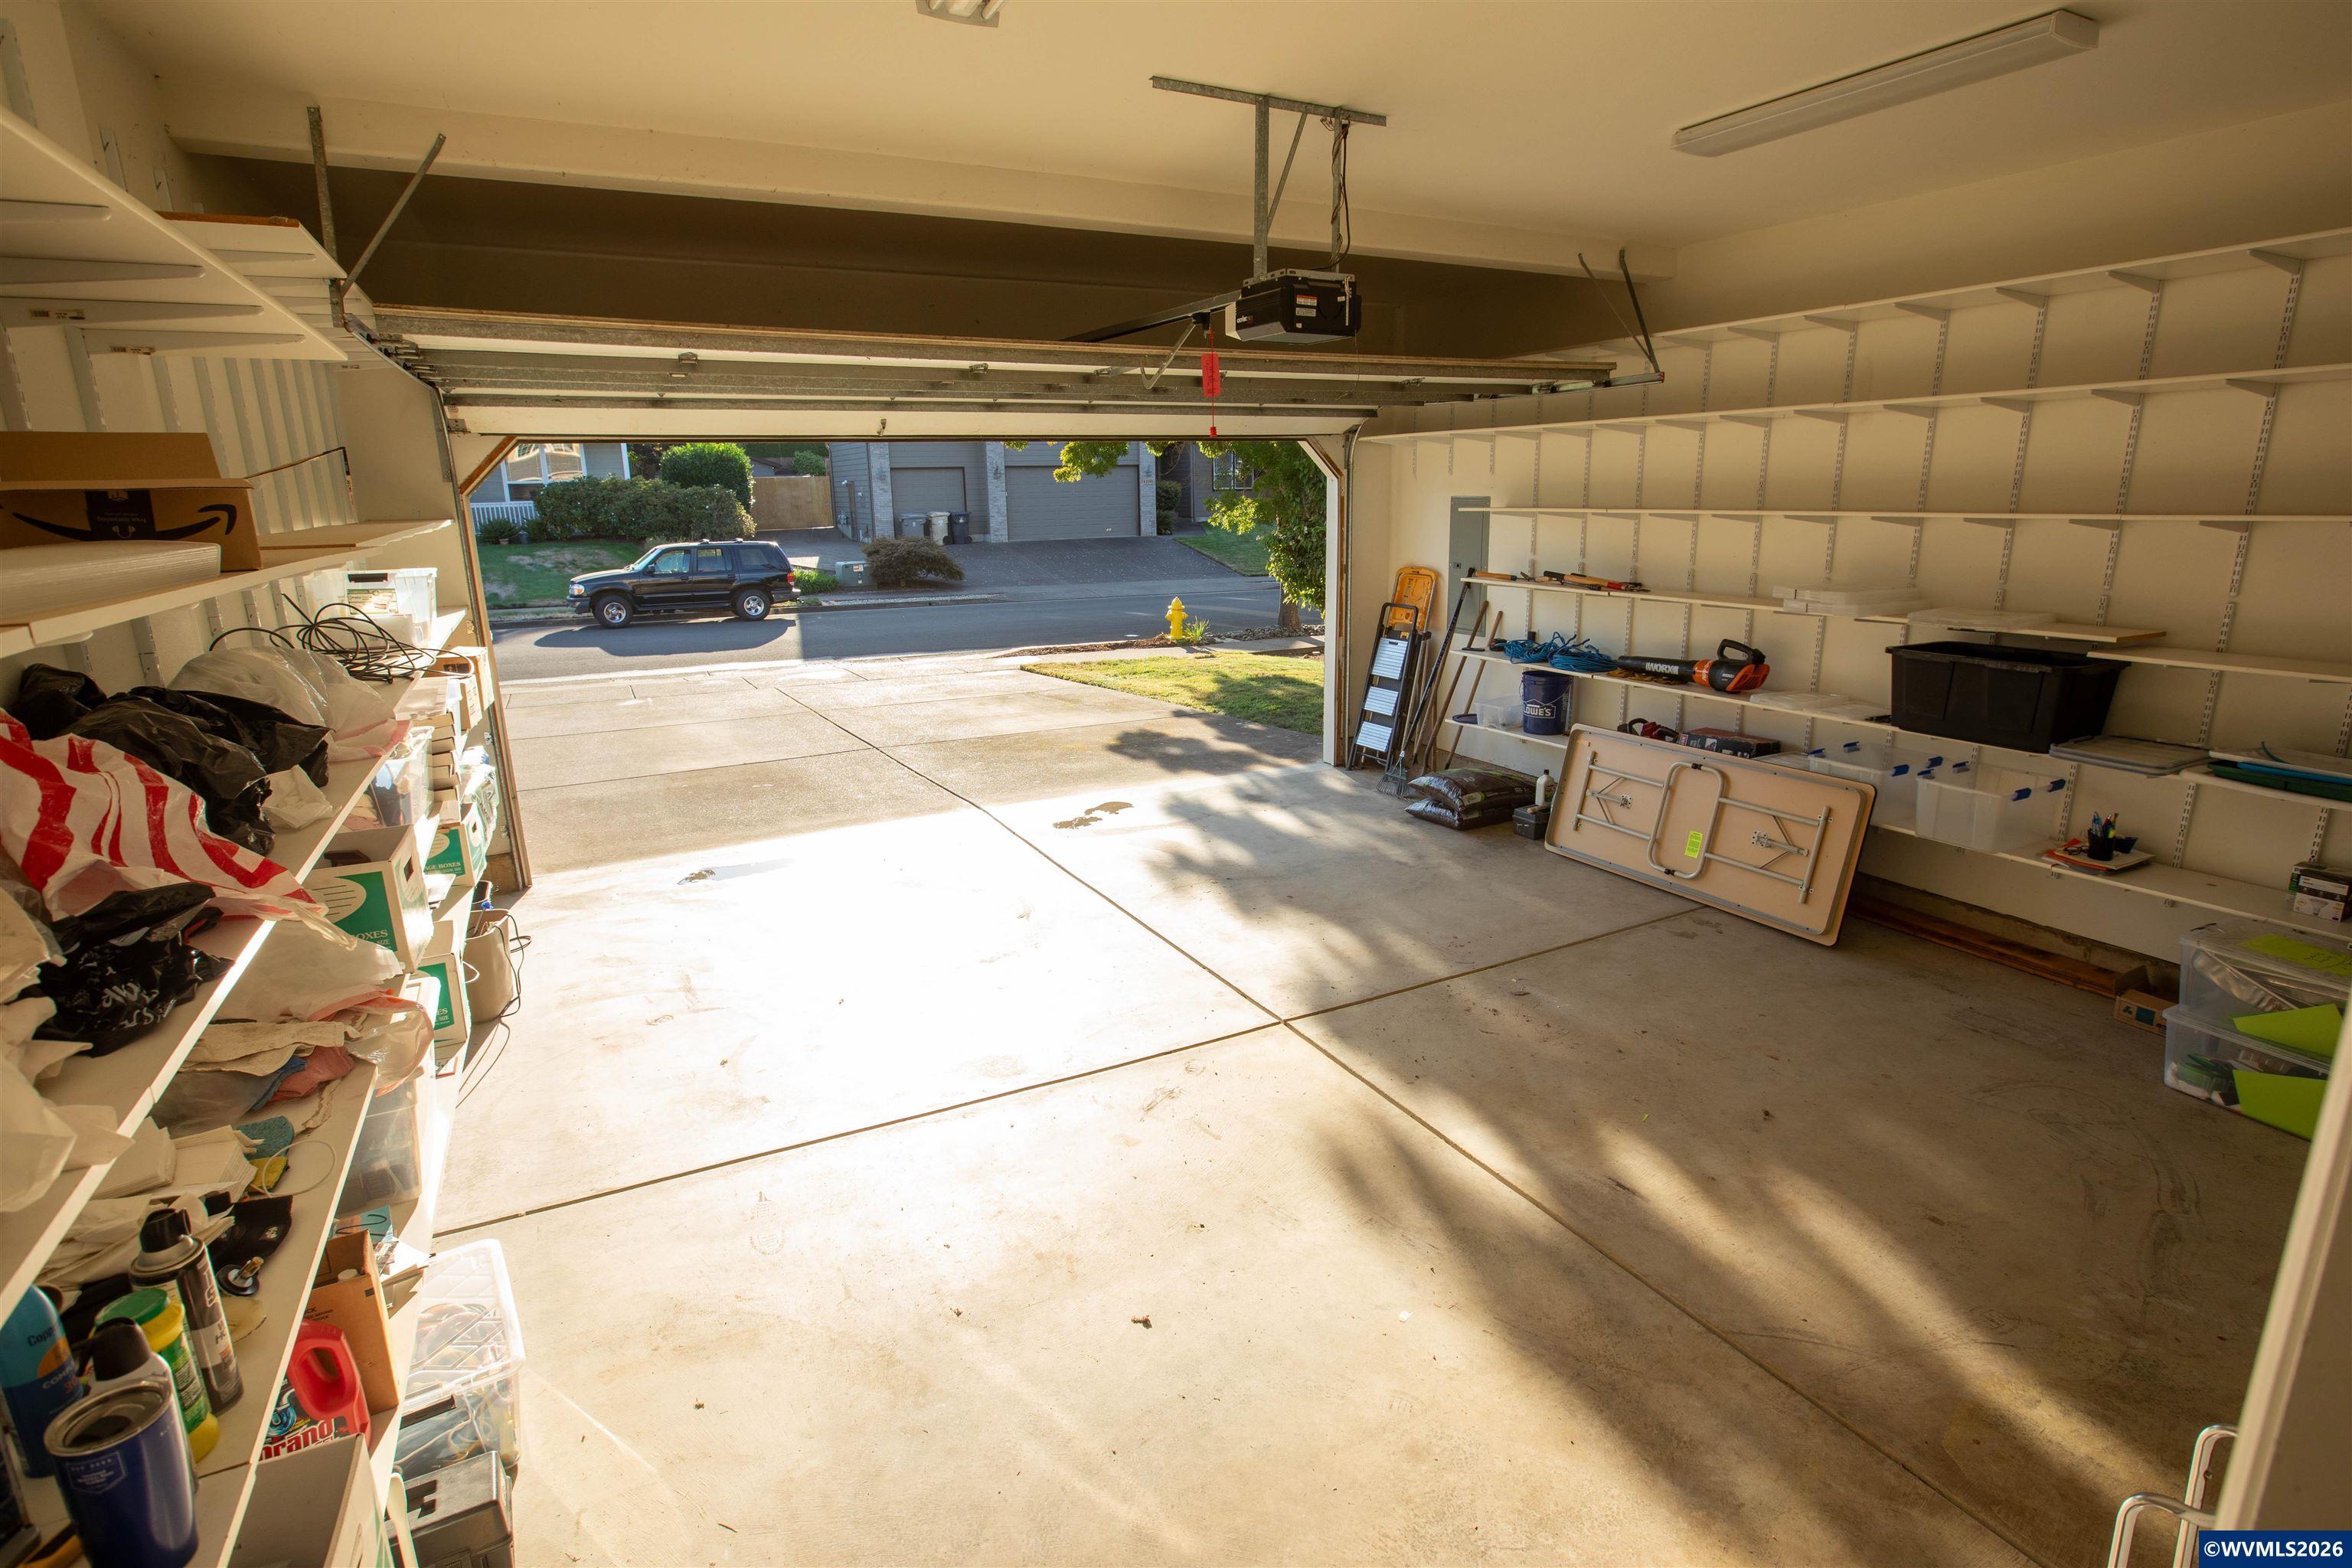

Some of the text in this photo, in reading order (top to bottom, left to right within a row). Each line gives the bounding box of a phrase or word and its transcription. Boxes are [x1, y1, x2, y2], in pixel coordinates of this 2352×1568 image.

[1645, 662, 1679, 675] WORX
[1523, 704, 1551, 717] LOWE'S
[438, 861, 461, 870] BOXES
[354, 929, 388, 940] OXES
